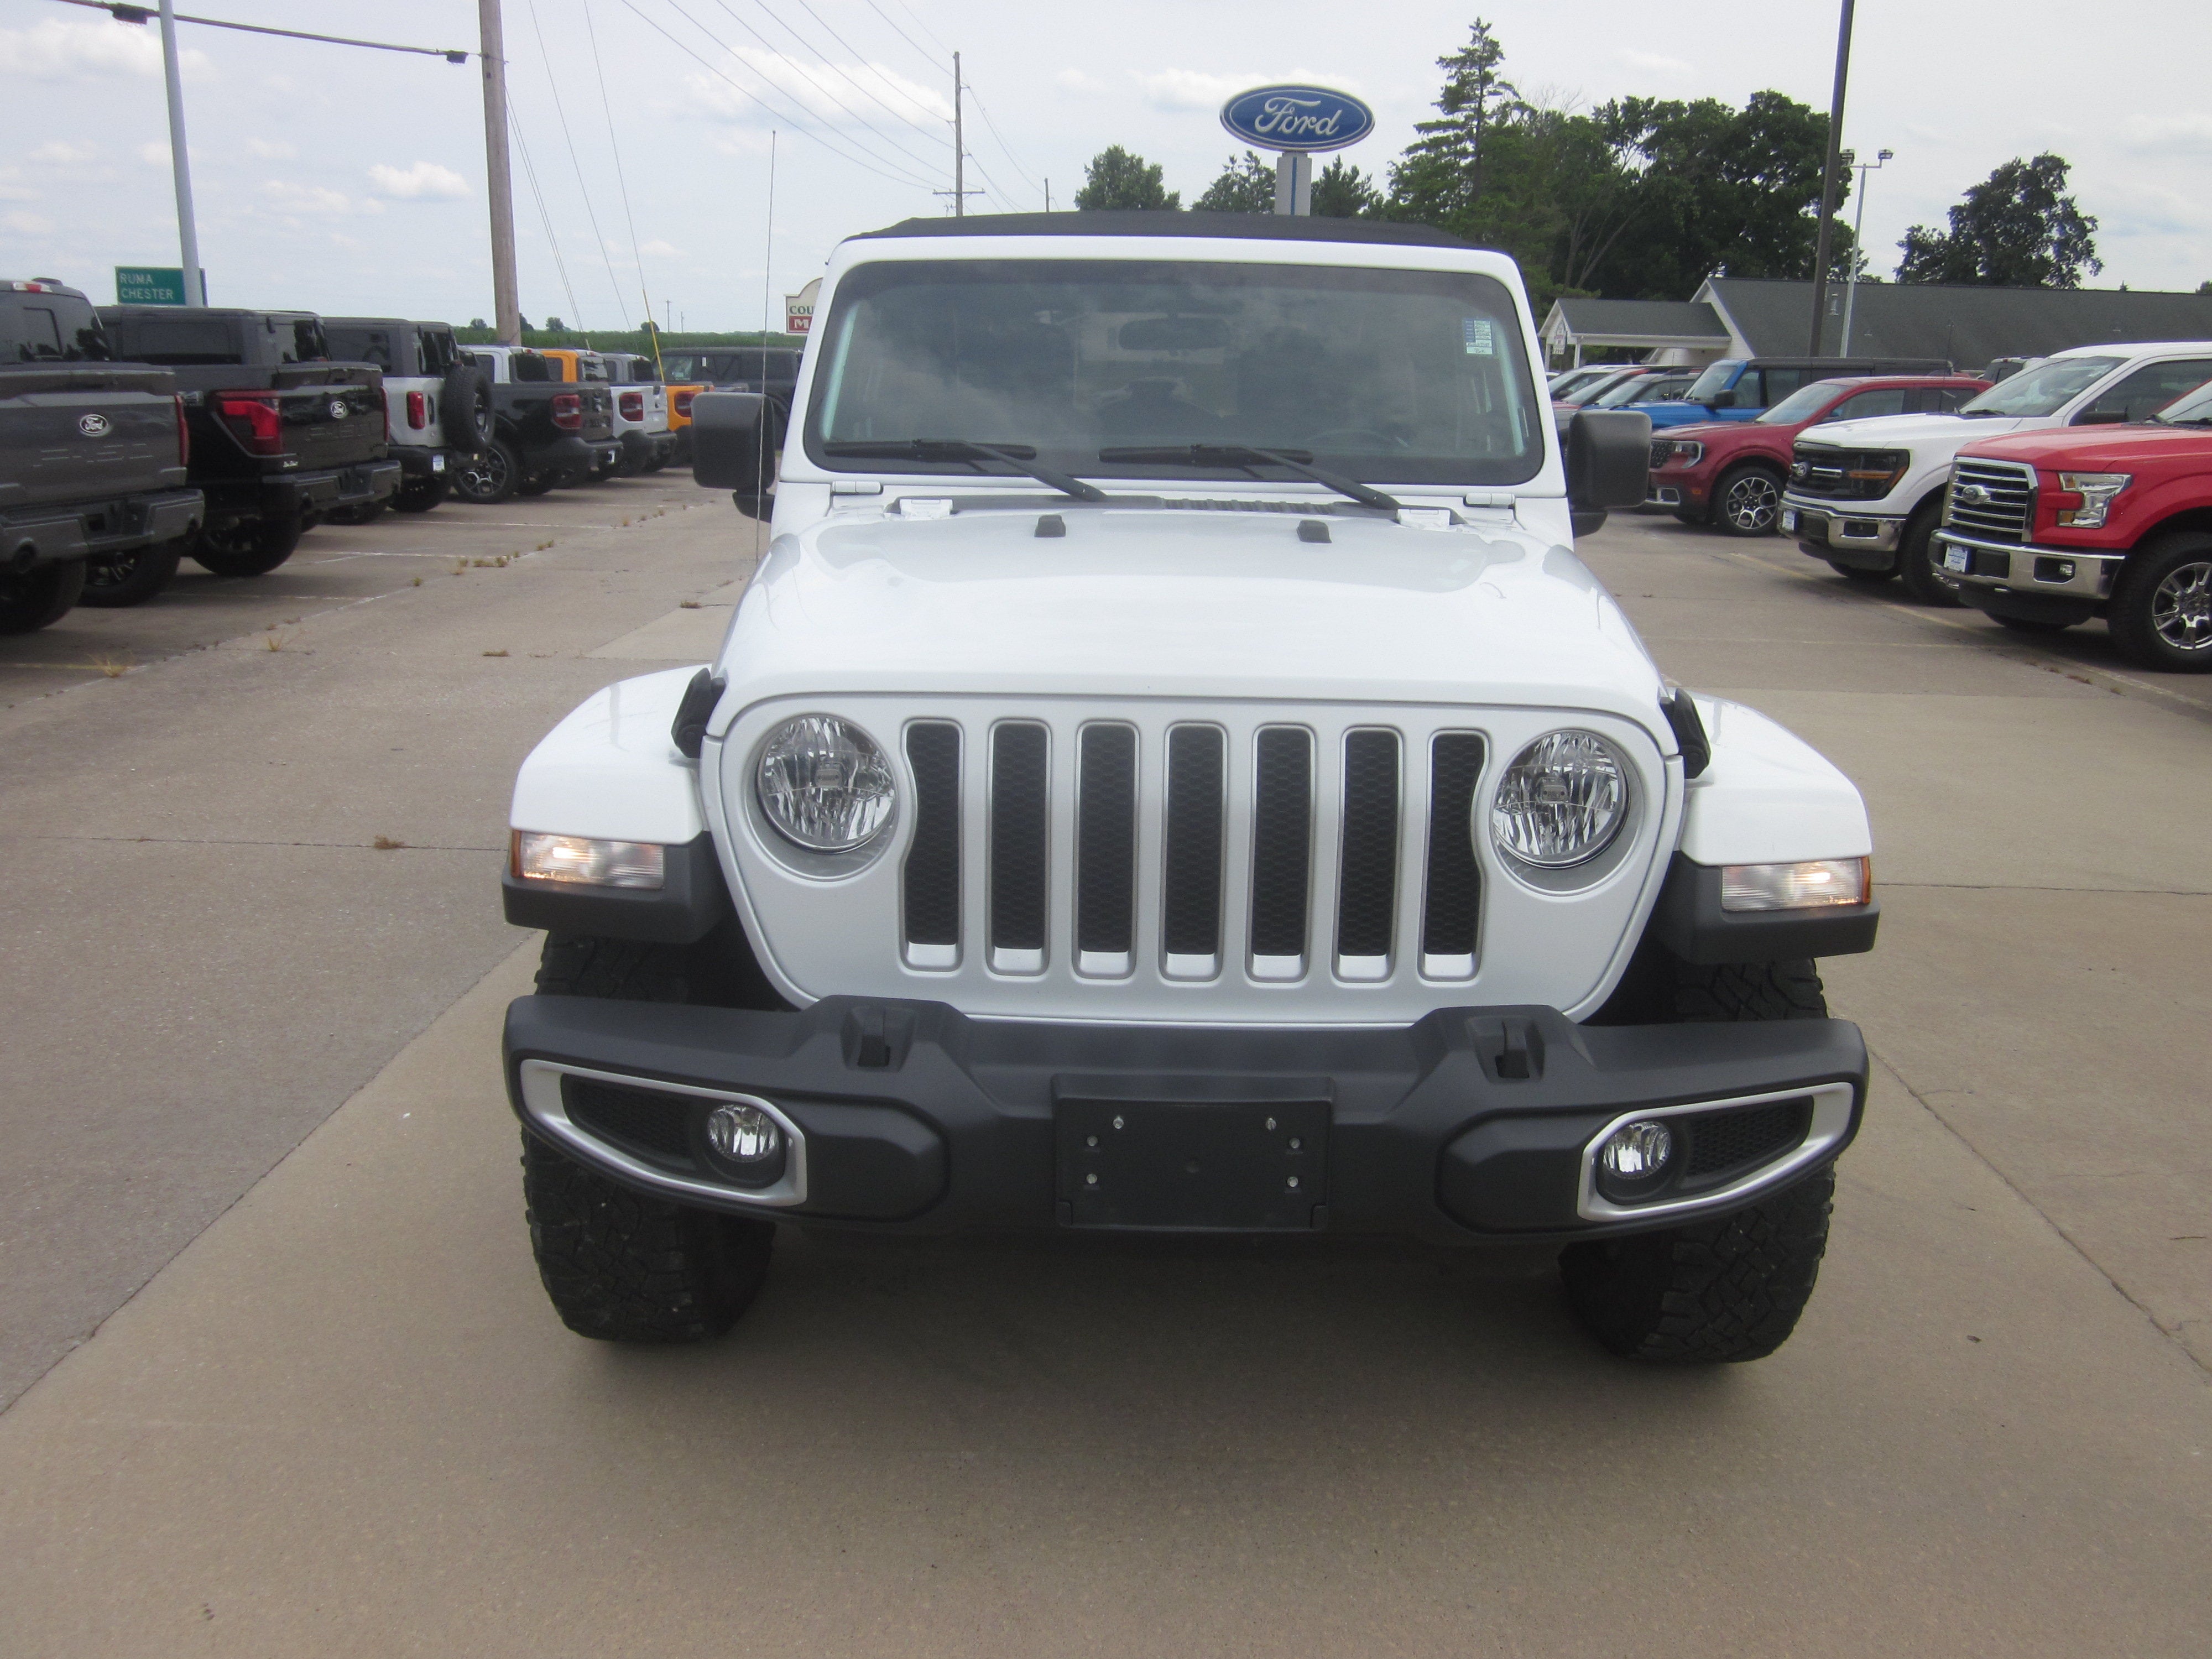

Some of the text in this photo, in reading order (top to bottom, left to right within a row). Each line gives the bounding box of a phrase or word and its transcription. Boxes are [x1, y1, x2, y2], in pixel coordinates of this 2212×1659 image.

[1255, 97, 1342, 135] Ford
[120, 273, 153, 285] RUMA
[122, 288, 173, 300] CHESTER
[85, 417, 104, 431] Ford
